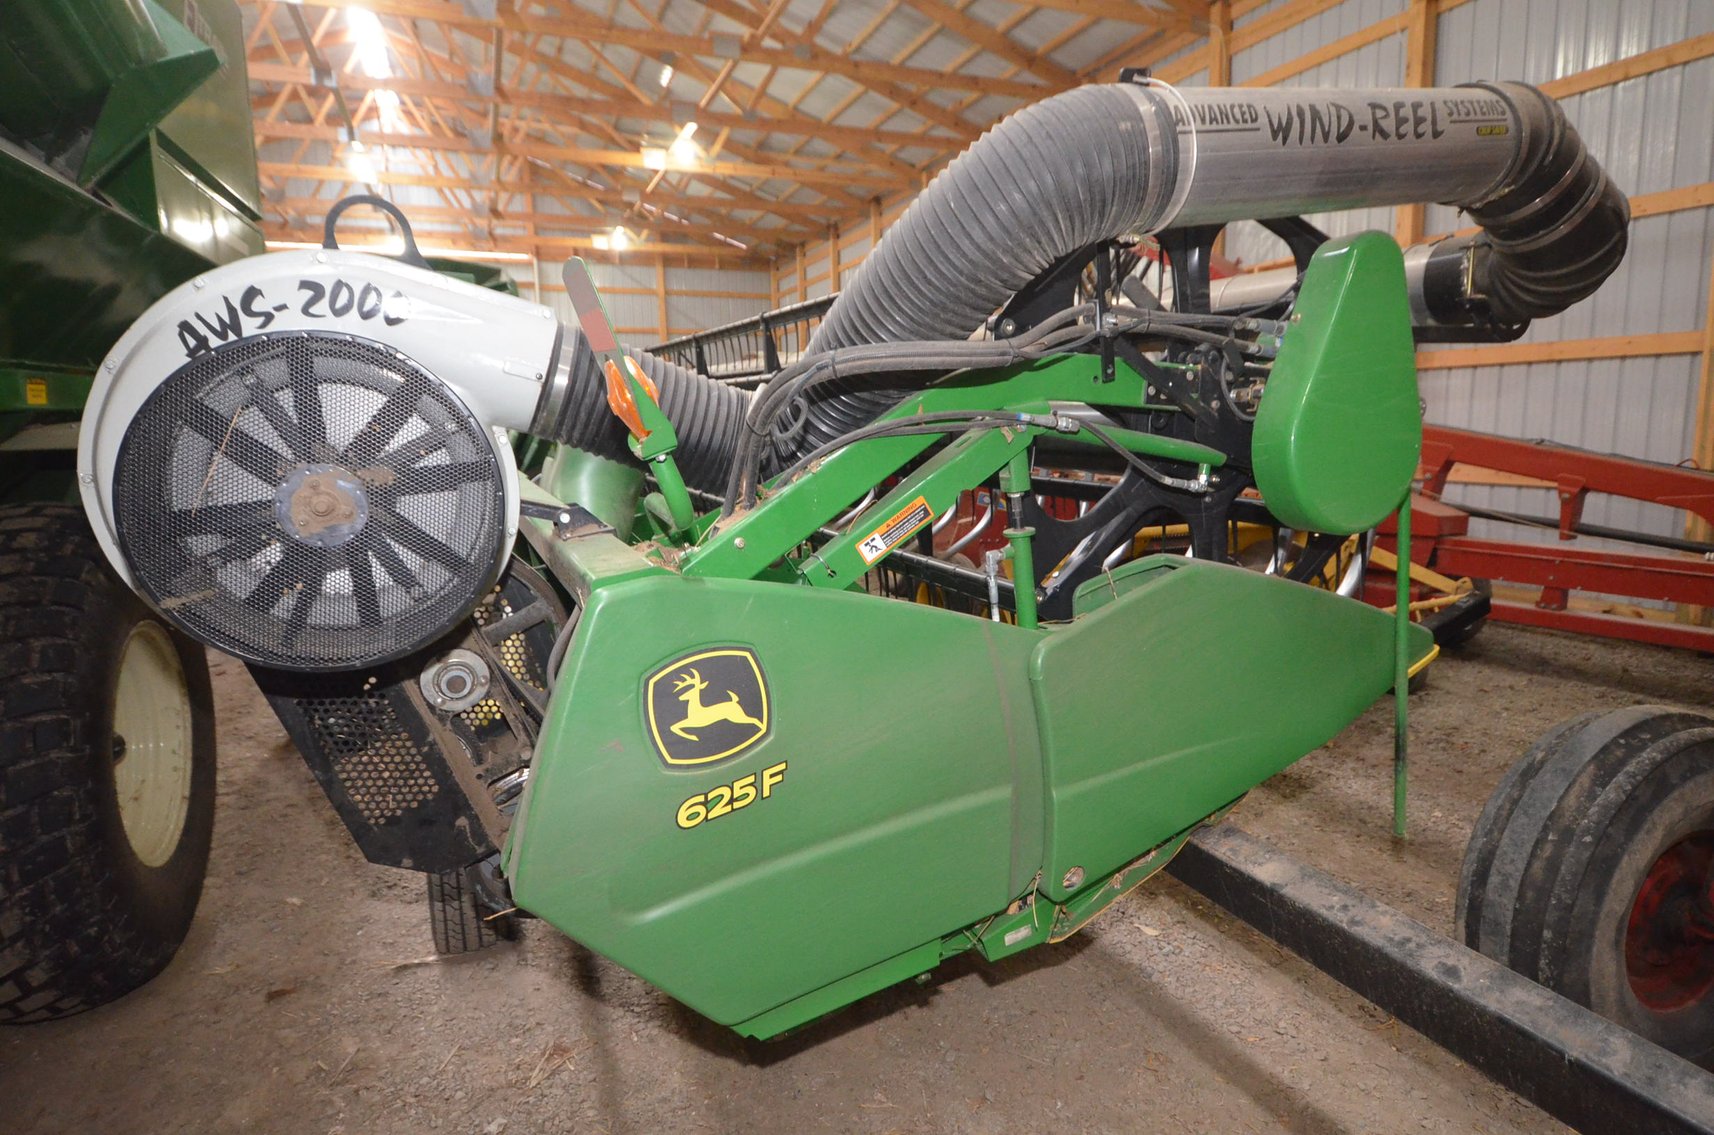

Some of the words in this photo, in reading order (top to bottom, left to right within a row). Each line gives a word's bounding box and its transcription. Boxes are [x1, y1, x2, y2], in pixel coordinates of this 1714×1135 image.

[1174, 103, 1259, 126] ADVANCED
[1264, 101, 1445, 146] WIND-REEL
[1443, 99, 1507, 117] SYSTEMS
[675, 760, 788, 830] 625F
